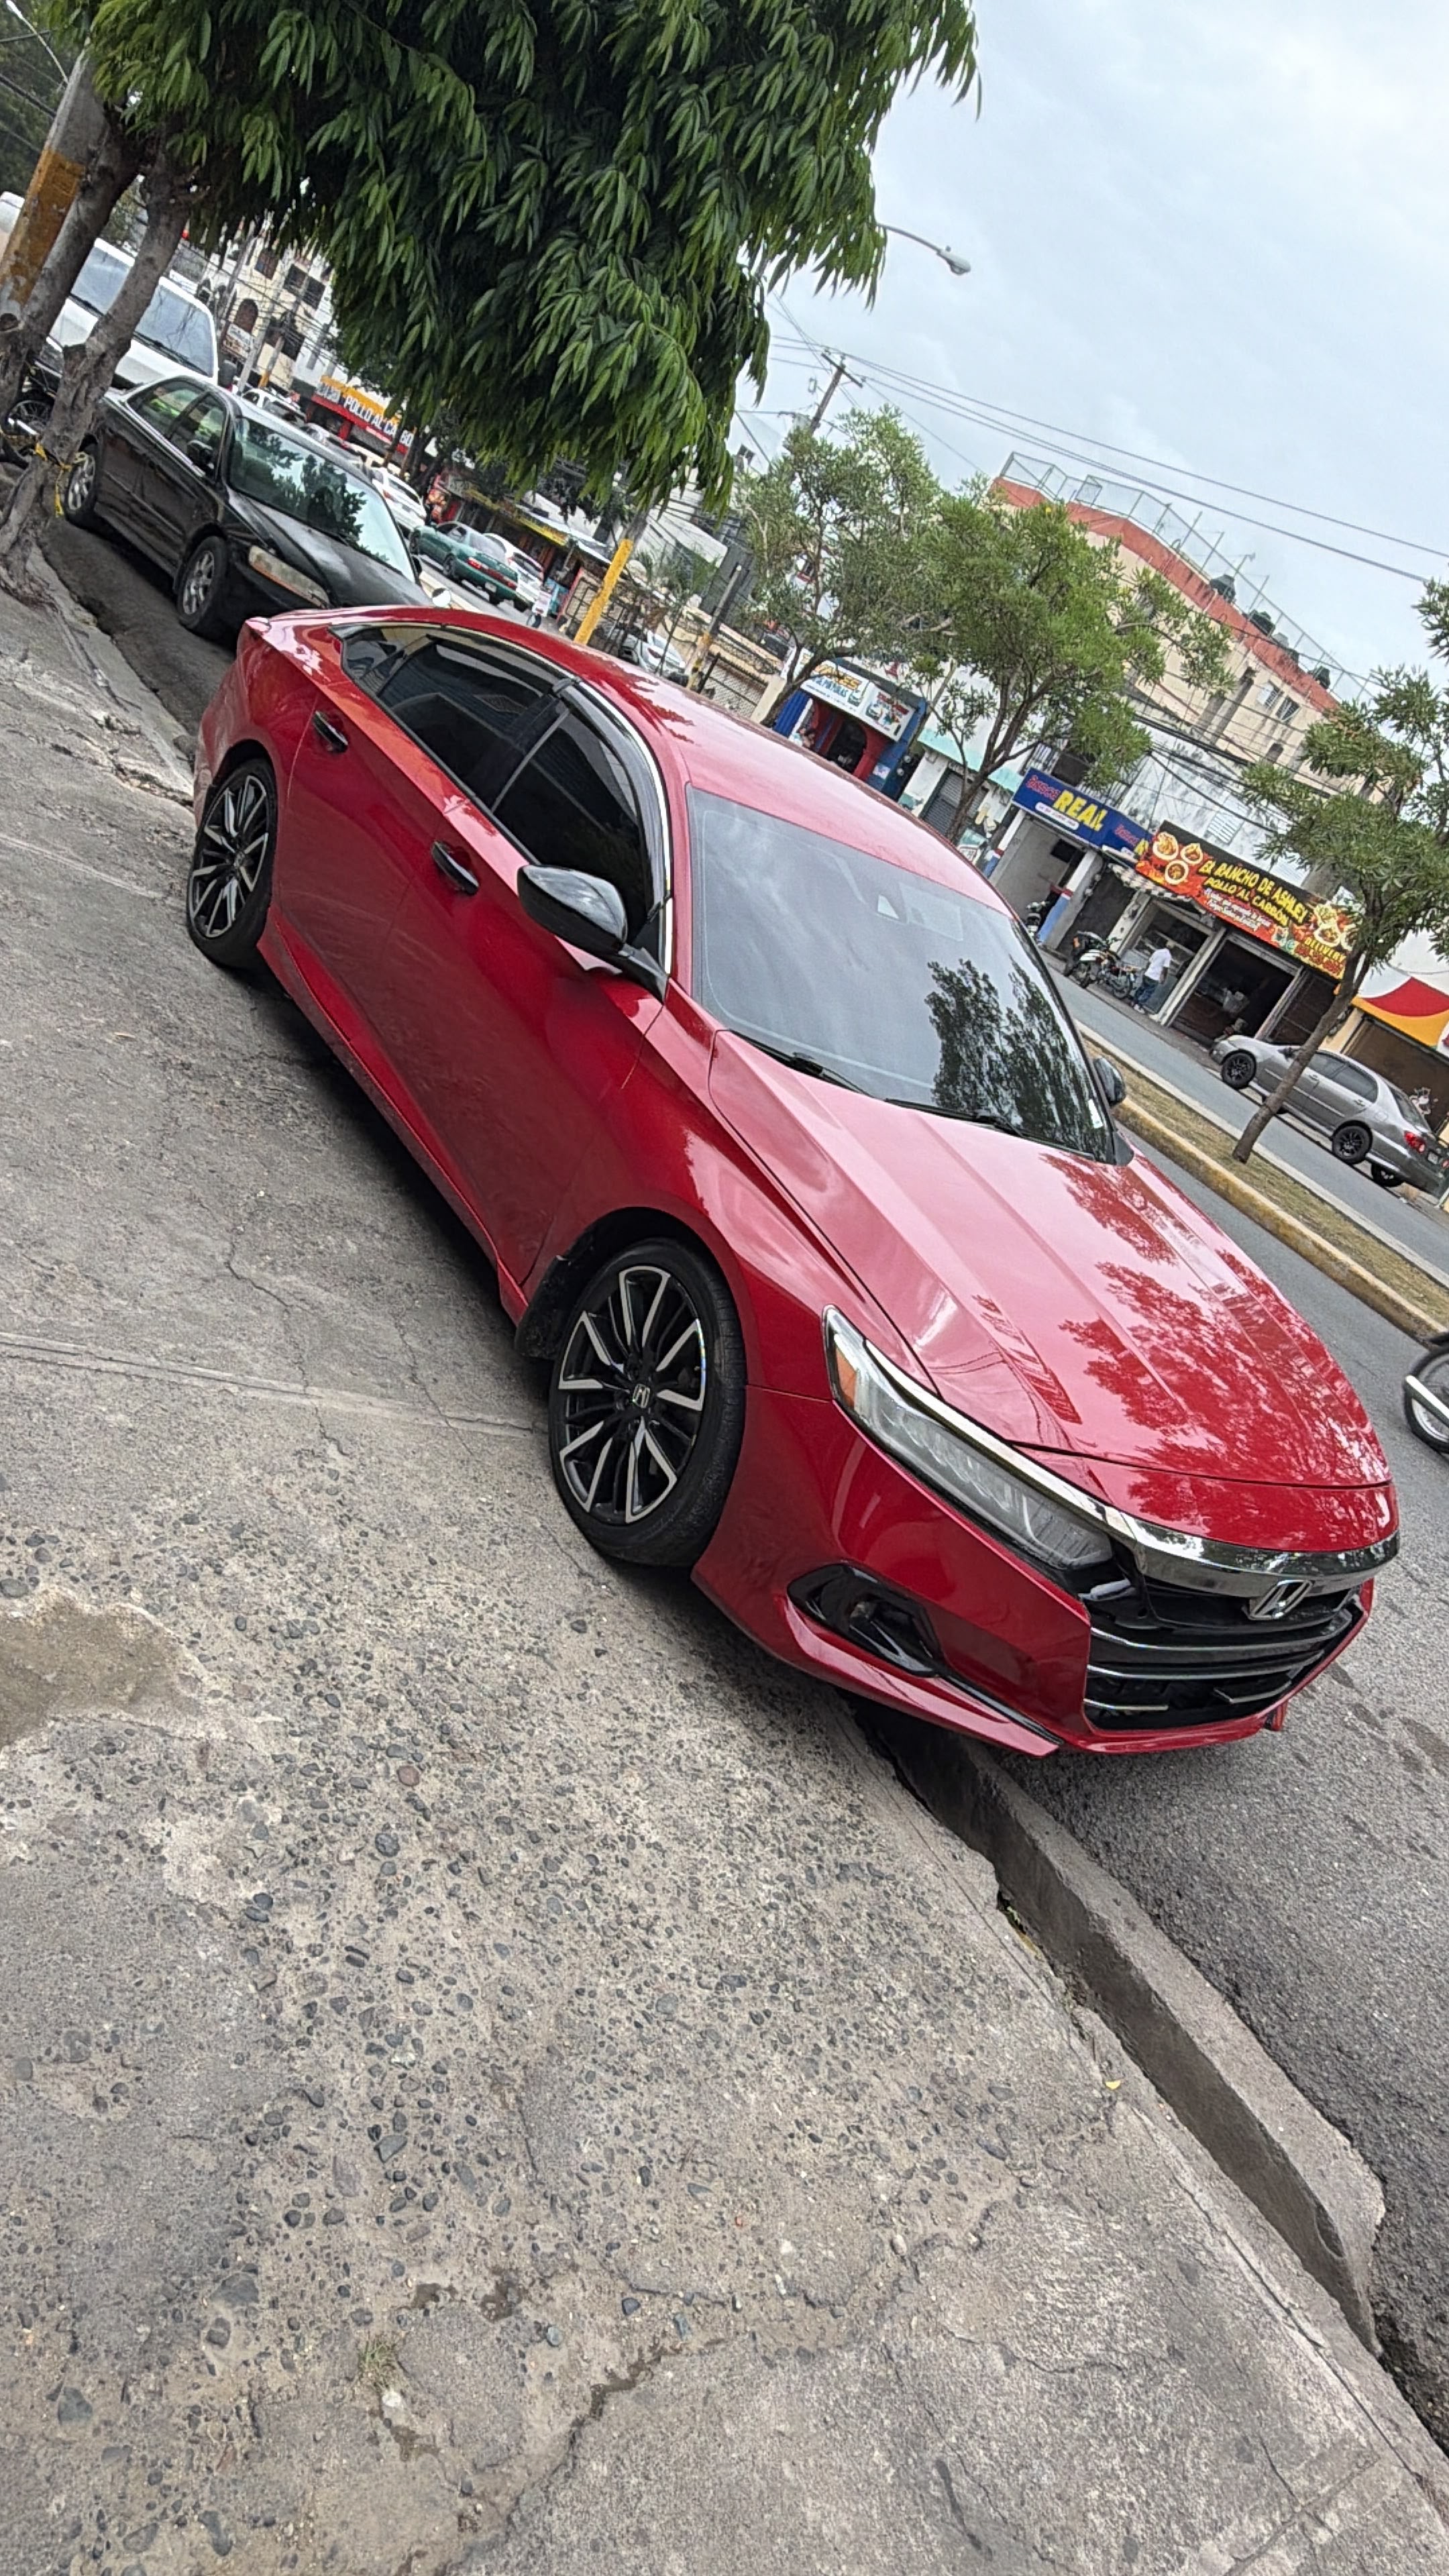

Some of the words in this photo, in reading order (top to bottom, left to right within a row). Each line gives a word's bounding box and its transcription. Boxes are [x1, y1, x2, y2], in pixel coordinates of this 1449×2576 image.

[343, 394, 374, 422] POLLO
[371, 414, 383, 429] AL
[1053, 790, 1108, 831] REAL
[1198, 860, 1216, 874] EL
[1216, 863, 1260, 888] RANCHO
[1256, 877, 1275, 896] DE
[1204, 877, 1237, 895] POLLO
[1236, 890, 1250, 901] AL
[1305, 936, 1346, 963] DELIVERY
